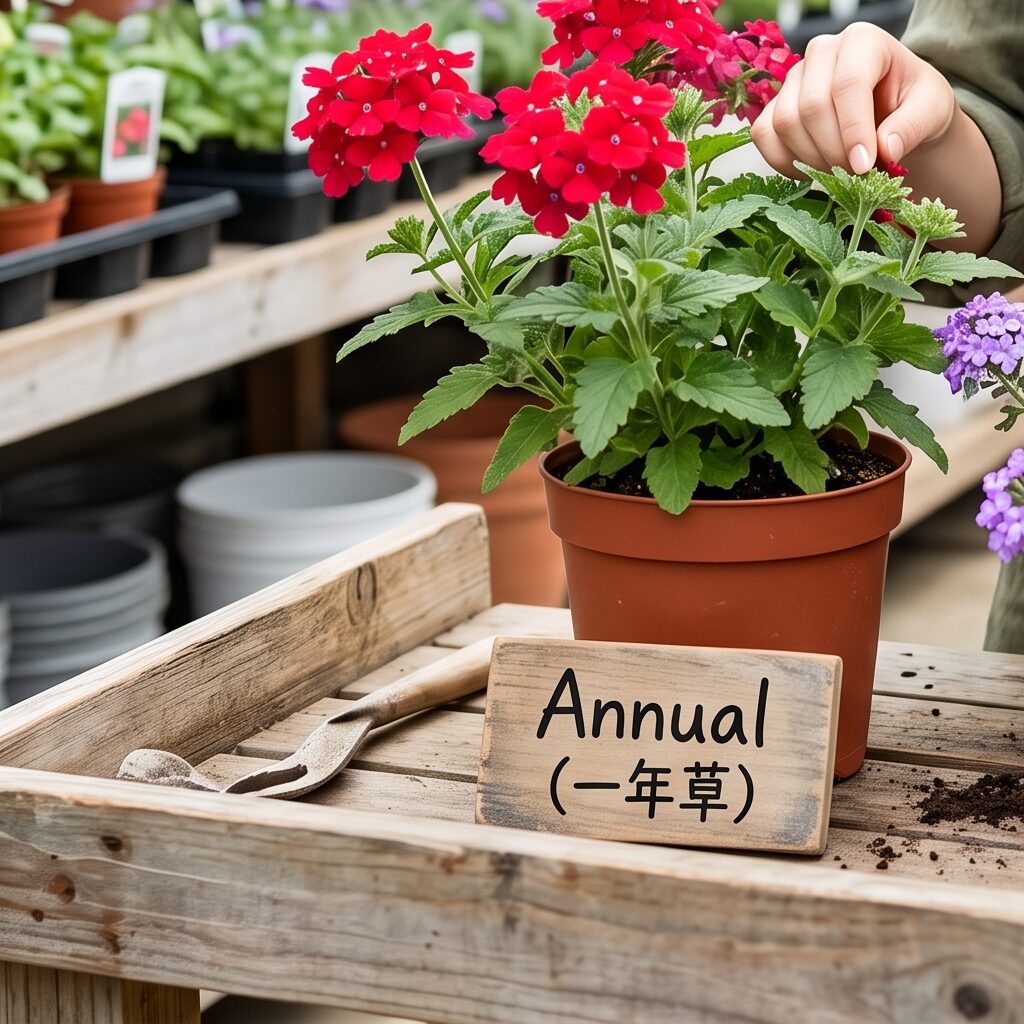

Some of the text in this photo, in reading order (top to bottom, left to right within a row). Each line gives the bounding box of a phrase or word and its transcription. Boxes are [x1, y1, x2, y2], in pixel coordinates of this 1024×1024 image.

[536, 667, 769, 748] Annual
[550, 756, 755, 824] (一年草)
